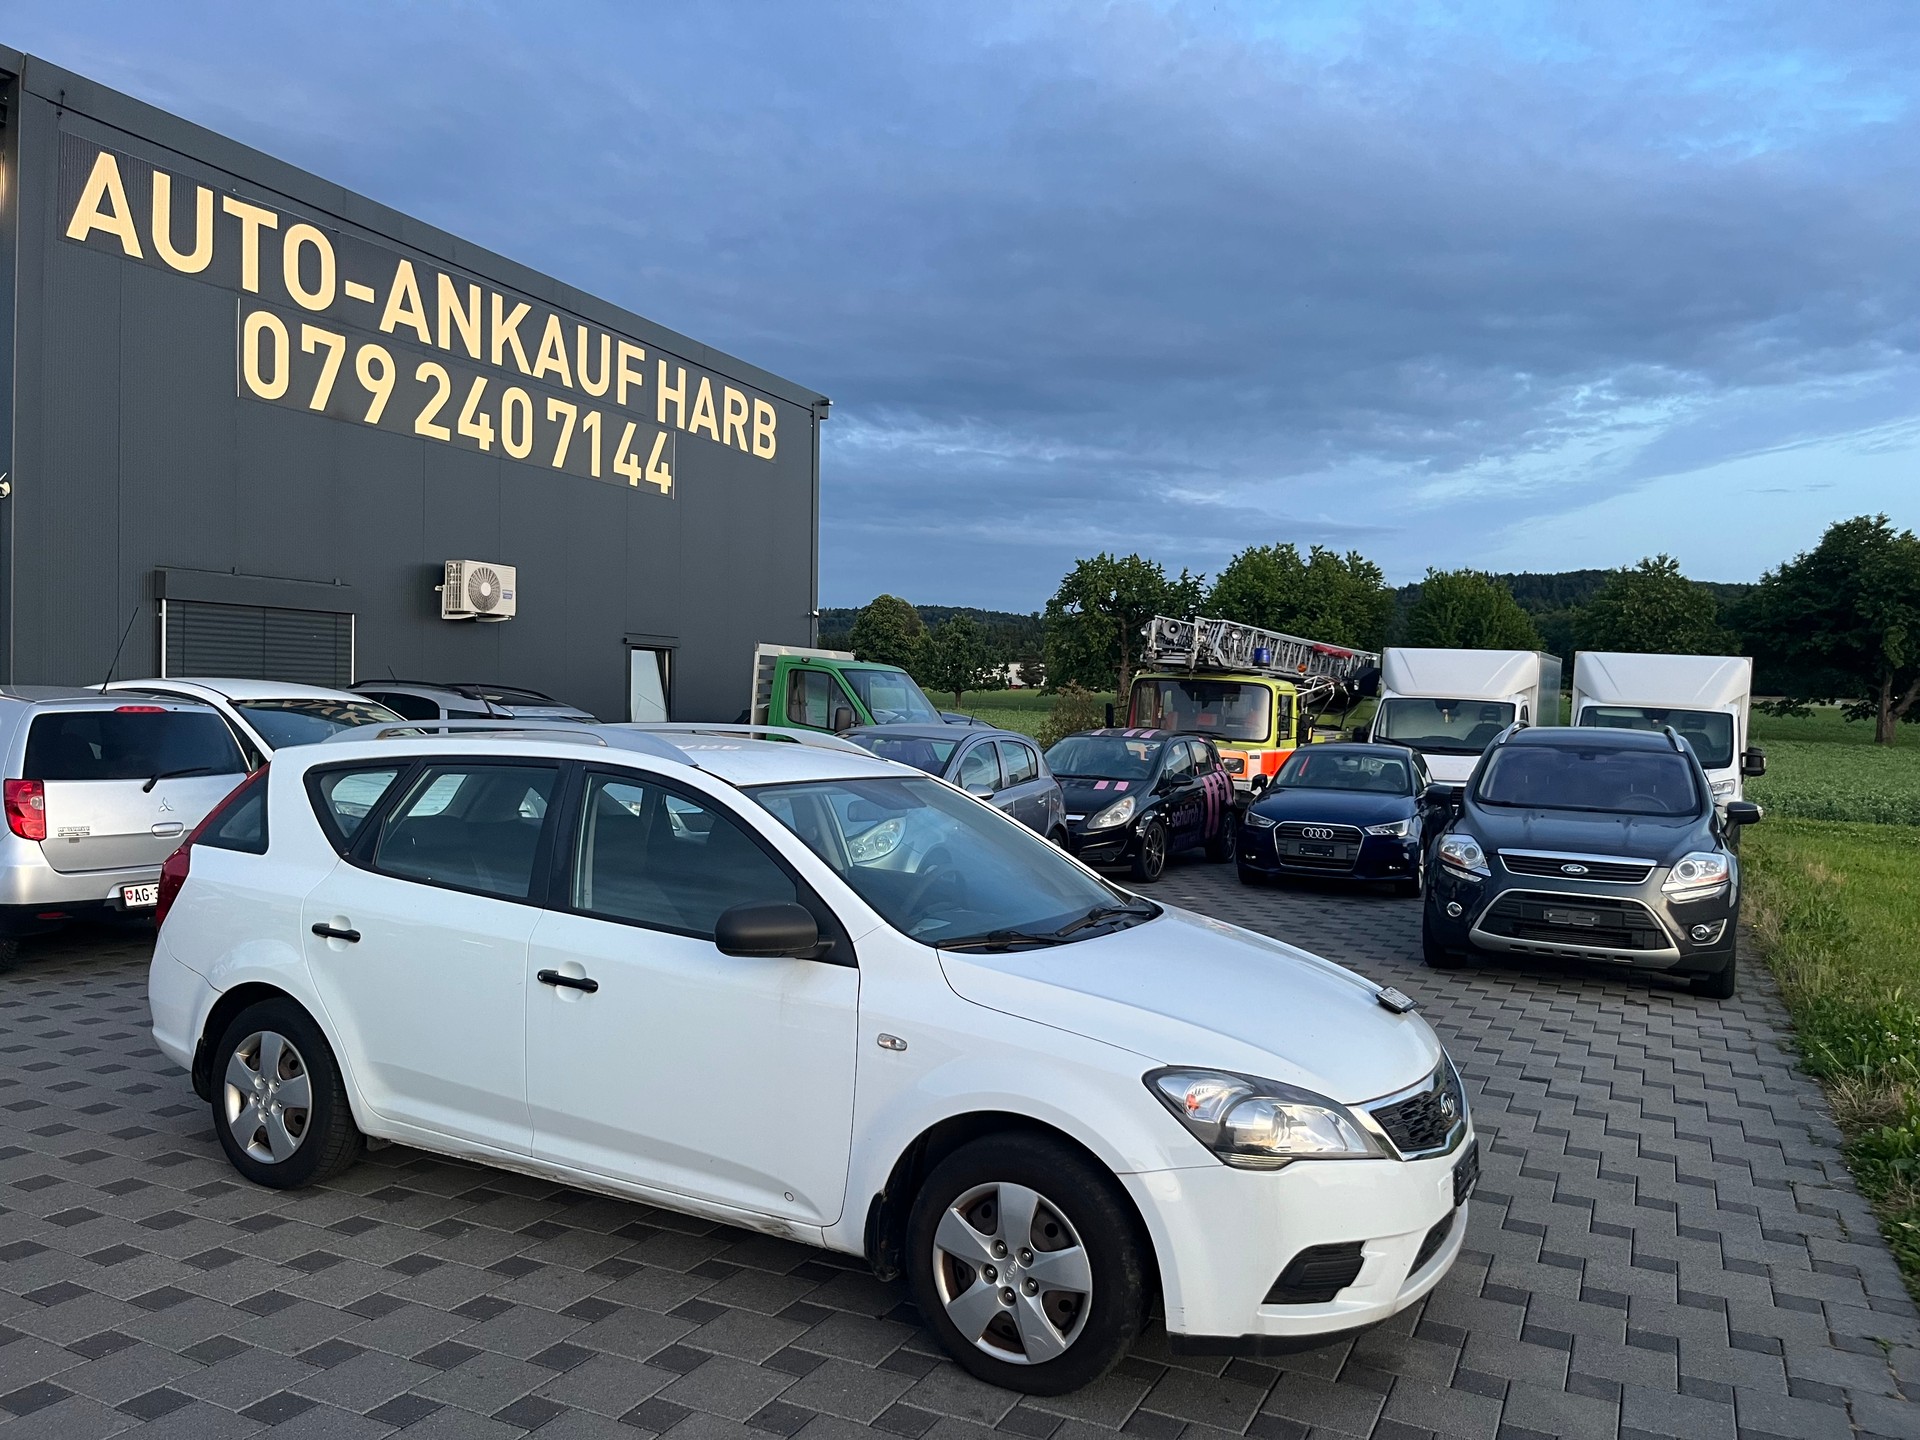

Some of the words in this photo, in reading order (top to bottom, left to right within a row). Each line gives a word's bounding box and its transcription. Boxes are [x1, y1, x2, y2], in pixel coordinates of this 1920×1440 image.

[66, 151, 645, 406] AUTO-ANKAUF
[657, 359, 777, 460] HARB
[243, 310, 396, 424] 079
[414, 361, 533, 459] 240
